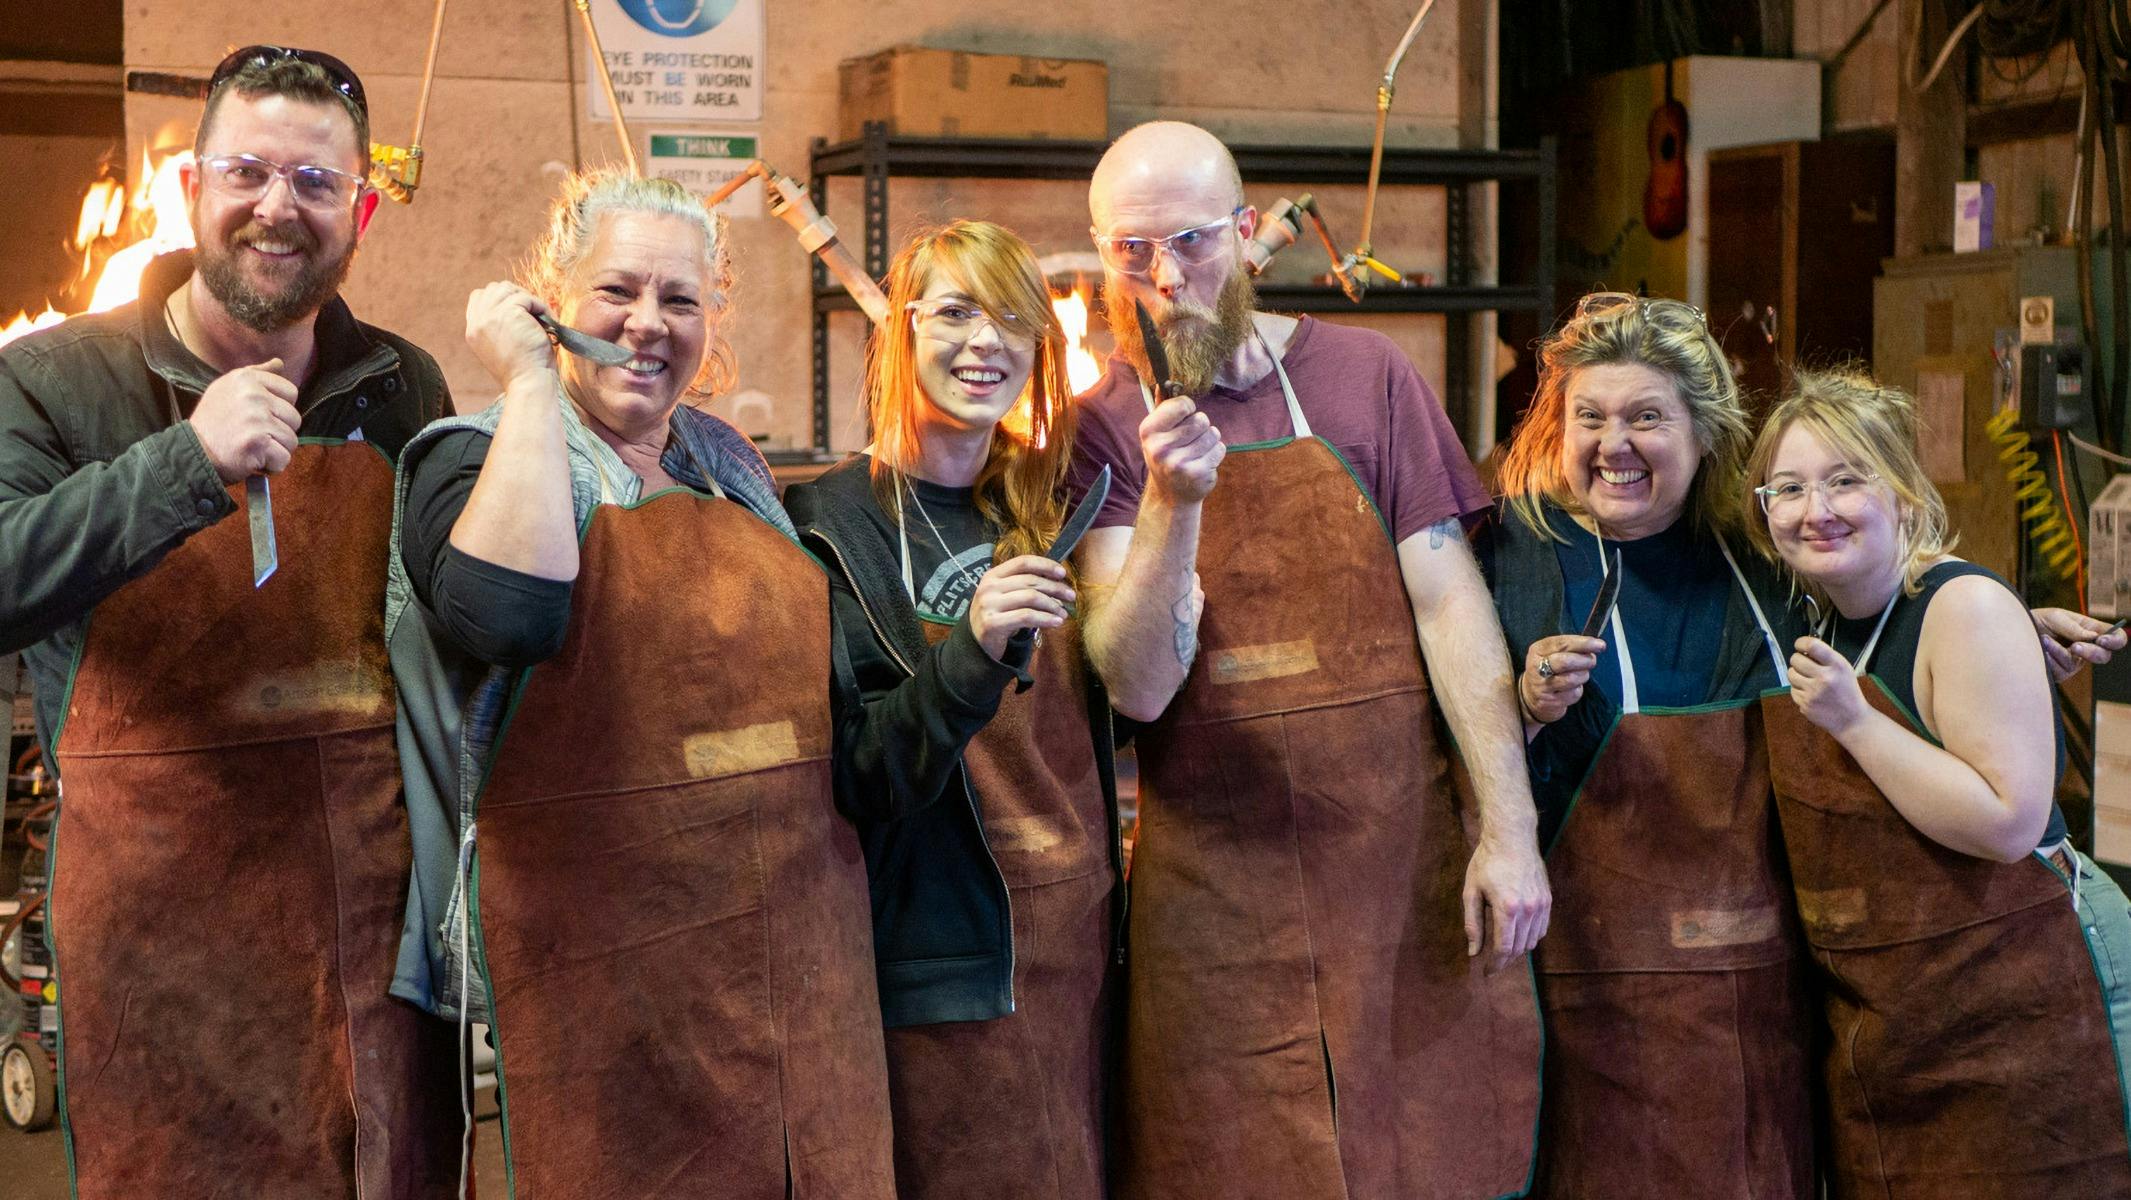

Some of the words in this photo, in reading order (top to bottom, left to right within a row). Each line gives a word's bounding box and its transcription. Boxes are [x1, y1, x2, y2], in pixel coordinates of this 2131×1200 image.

[604, 51, 632, 66] EYE
[643, 53, 753, 69] PROTECTION
[610, 71, 654, 86] MUST
[665, 72, 685, 86] BE
[696, 74, 751, 88] WORN
[645, 91, 683, 105] THIS
[694, 93, 738, 107] AREA
[676, 138, 730, 156] THINK
